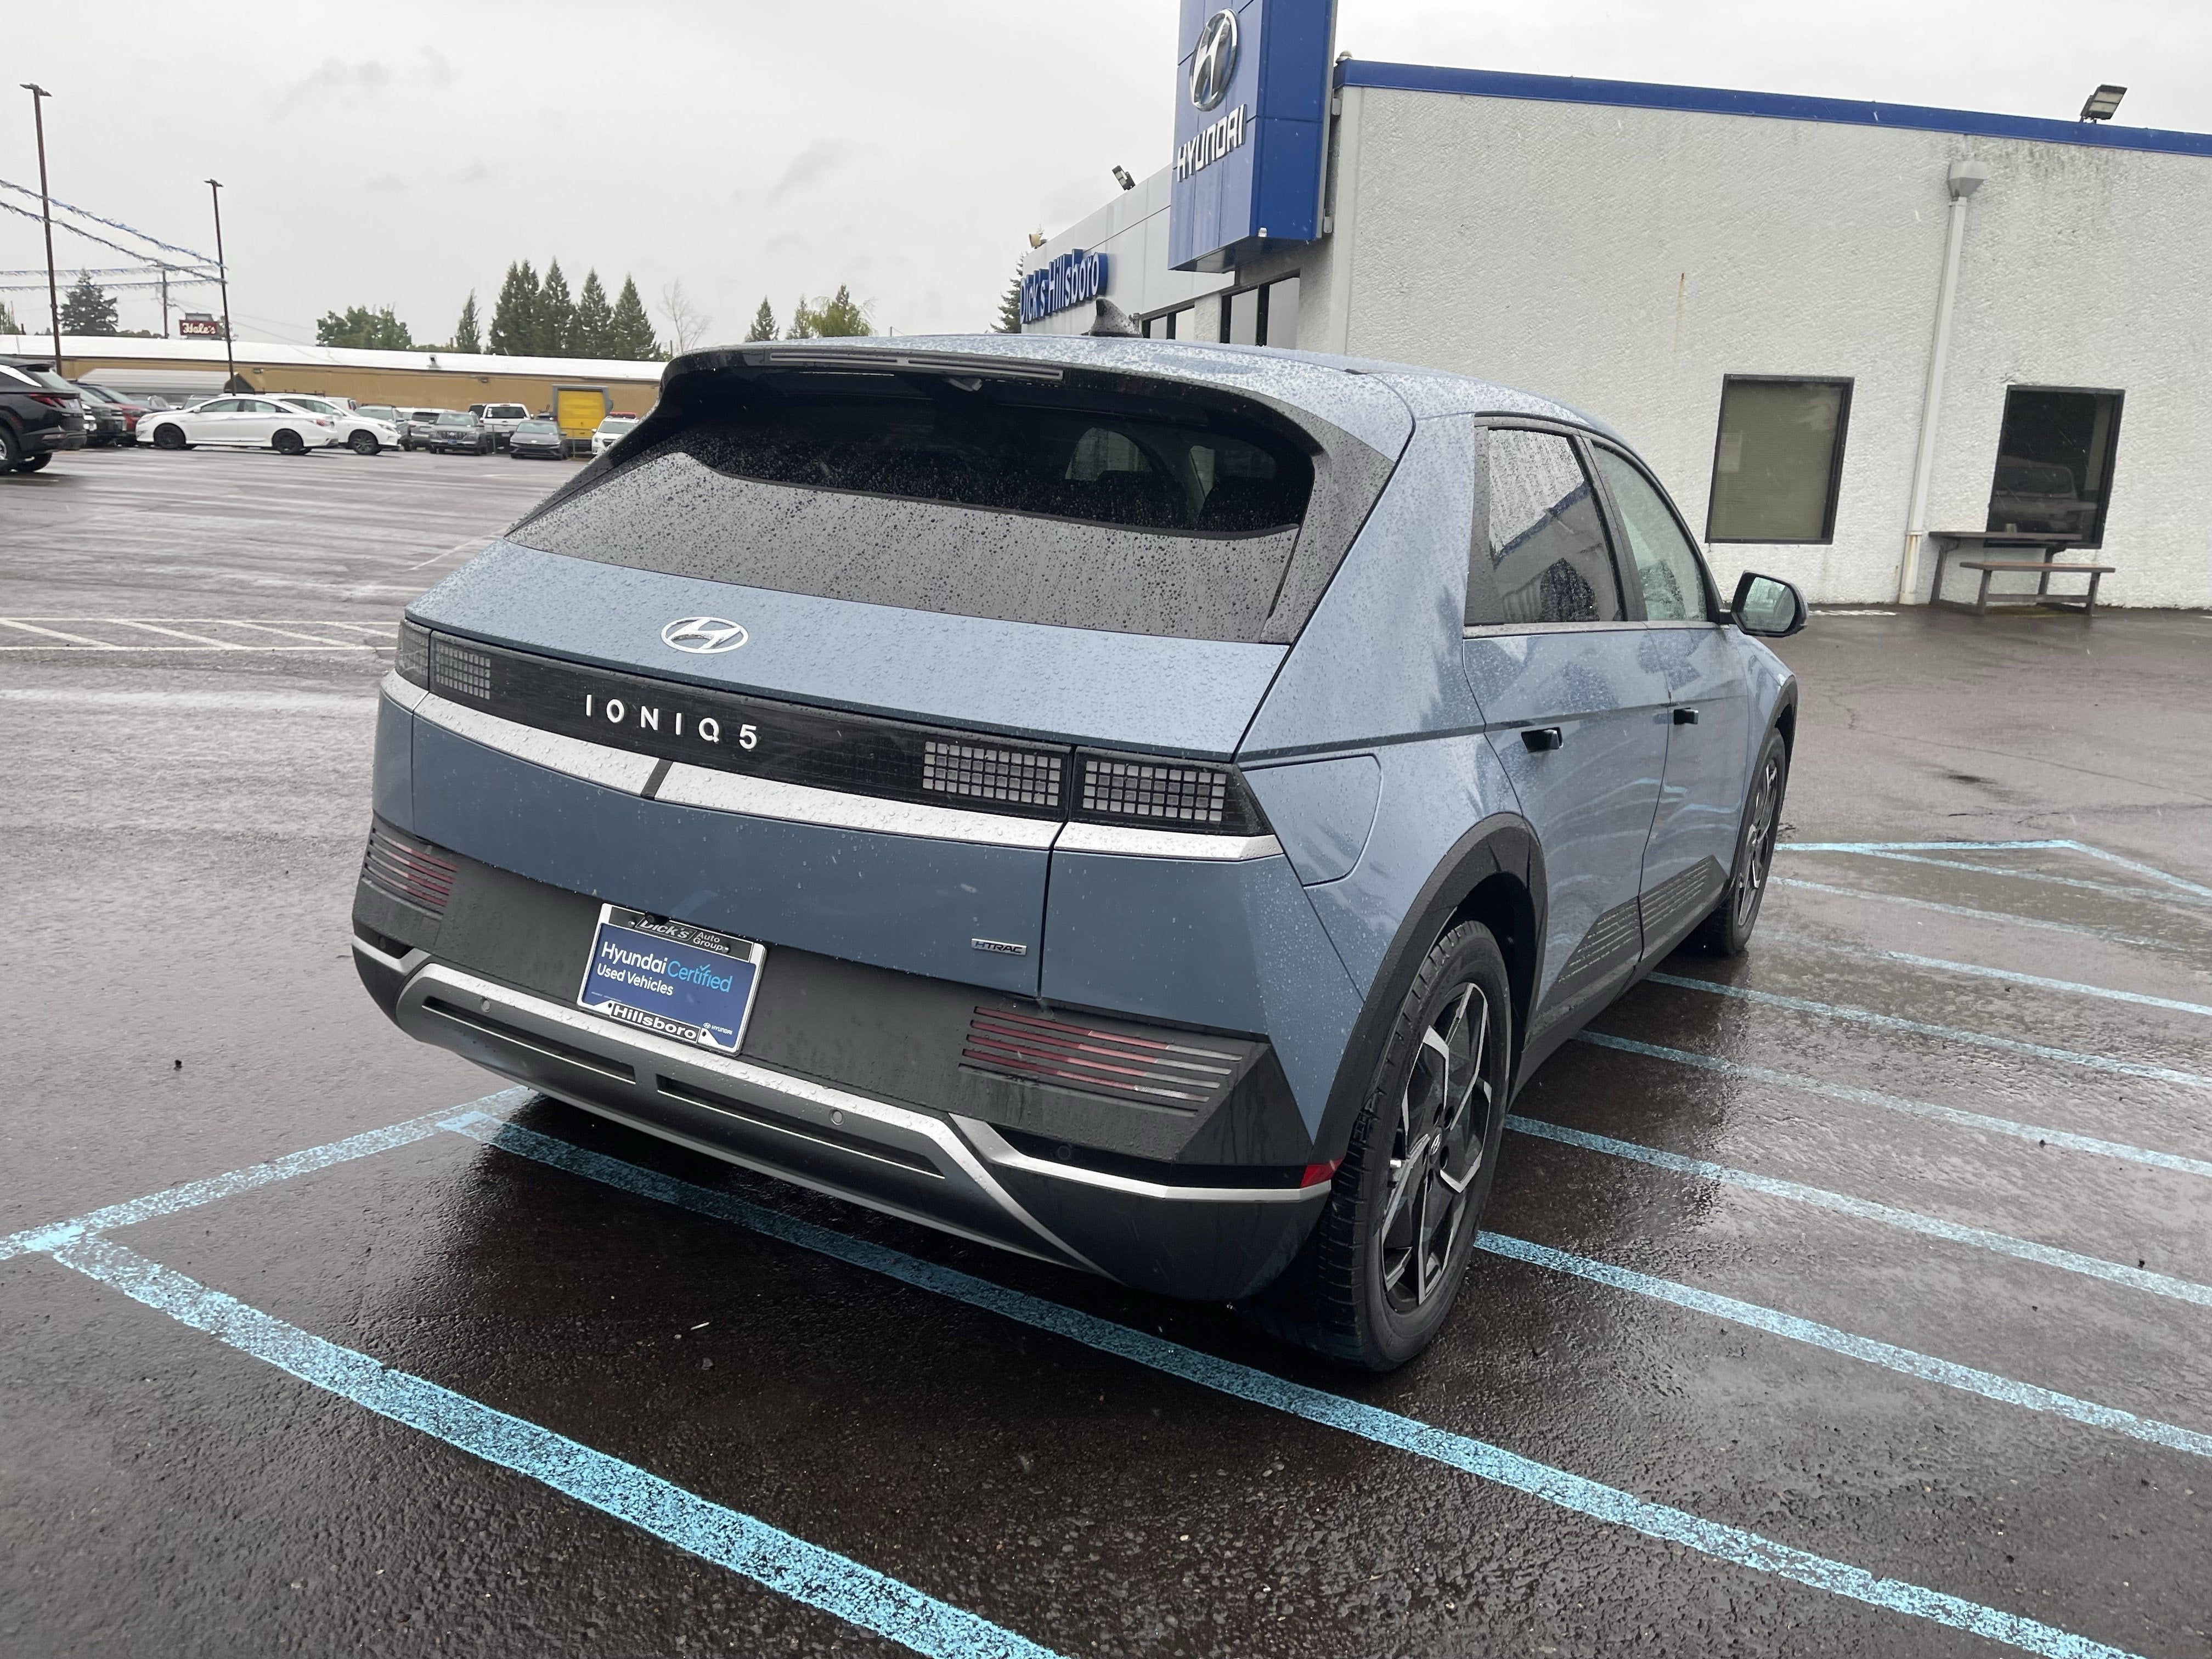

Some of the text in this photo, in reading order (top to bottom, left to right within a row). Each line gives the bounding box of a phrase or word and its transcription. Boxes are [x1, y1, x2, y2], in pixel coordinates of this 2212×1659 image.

[1177, 104, 1246, 182] HYUNDAI
[1020, 250, 1099, 324] Dick's Hillsboro
[182, 322, 216, 335] Hale's
[585, 693, 758, 750] IONIQ 5
[692, 937, 724, 951] Group
[696, 932, 720, 943] Auto
[975, 940, 1023, 953] HTRAC
[597, 963, 674, 996] Used Vehicles
[601, 941, 733, 993] Hyundai Certified
[613, 1005, 697, 1039] Hillsboro
[711, 1025, 733, 1035] HYUNDAI
